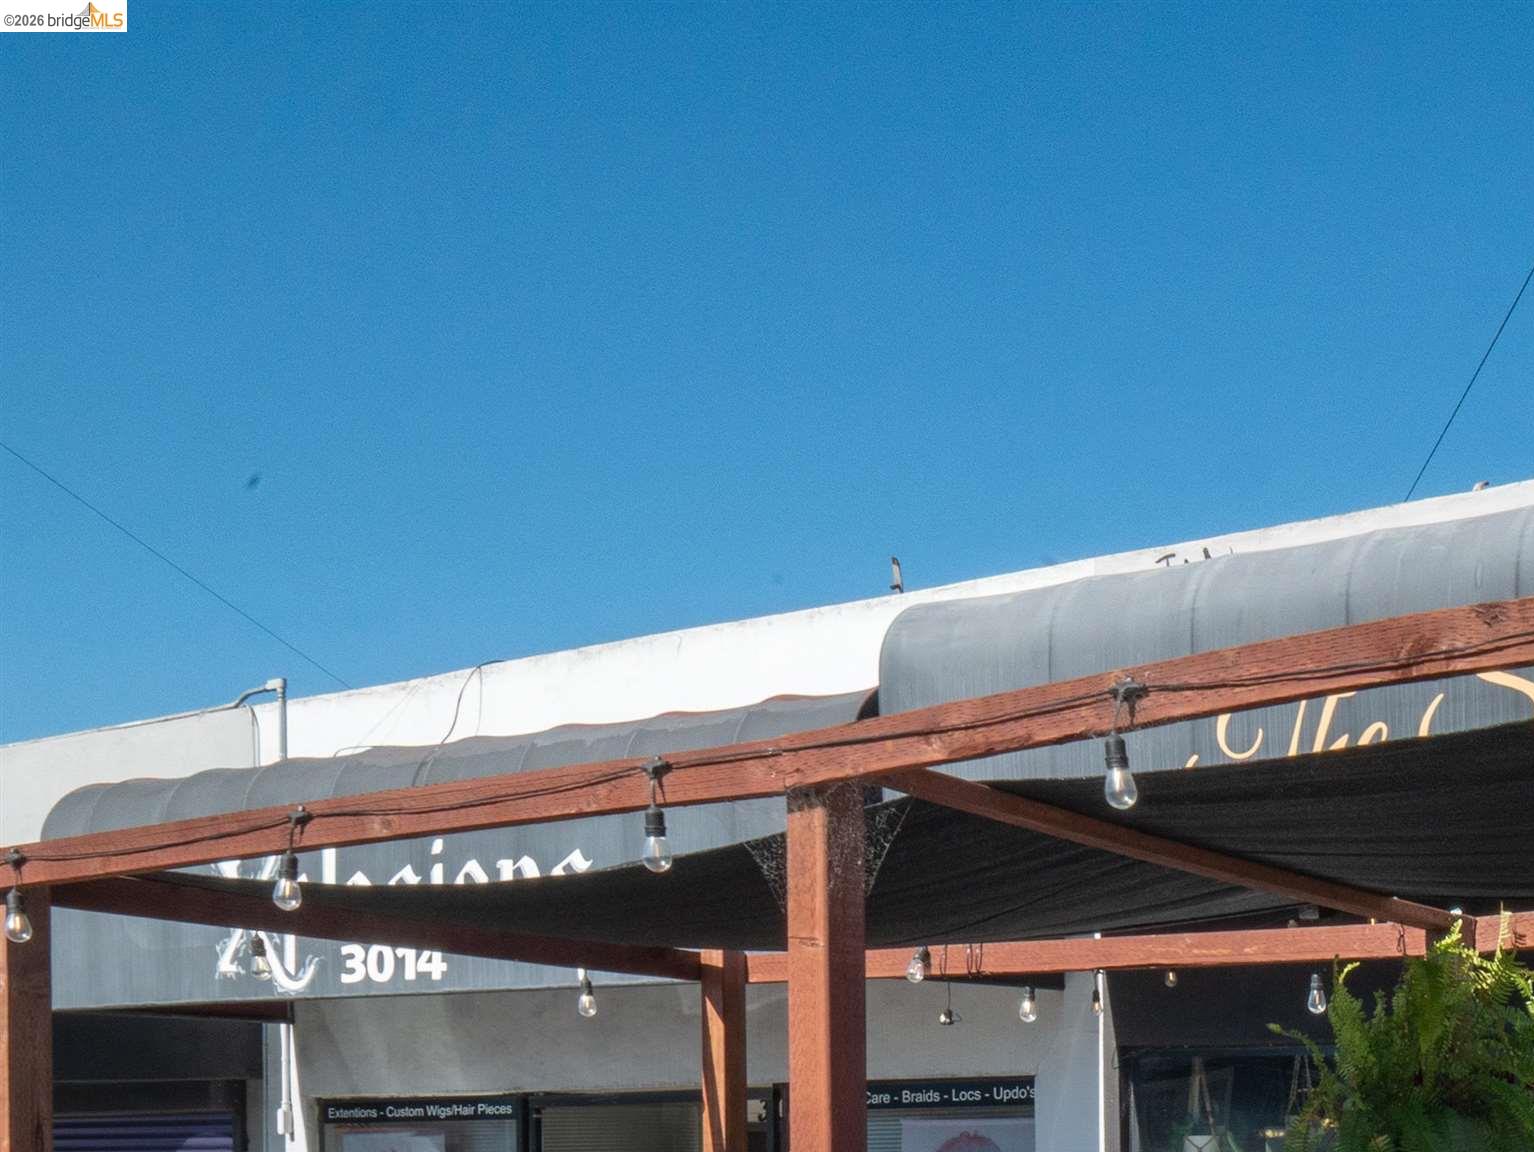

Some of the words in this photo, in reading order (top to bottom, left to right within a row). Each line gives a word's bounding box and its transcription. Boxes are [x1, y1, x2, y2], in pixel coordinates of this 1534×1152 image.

[340, 944, 447, 984] 3014
[902, 1089, 940, 1104] Braids
[952, 1088, 981, 1101] Locs
[993, 1086, 1036, 1103] Updo's
[328, 1106, 377, 1119] Extentions
[386, 1105, 424, 1118] Custom
[426, 1104, 475, 1119] Wigs/Hair
[477, 1103, 512, 1115] Pieces
